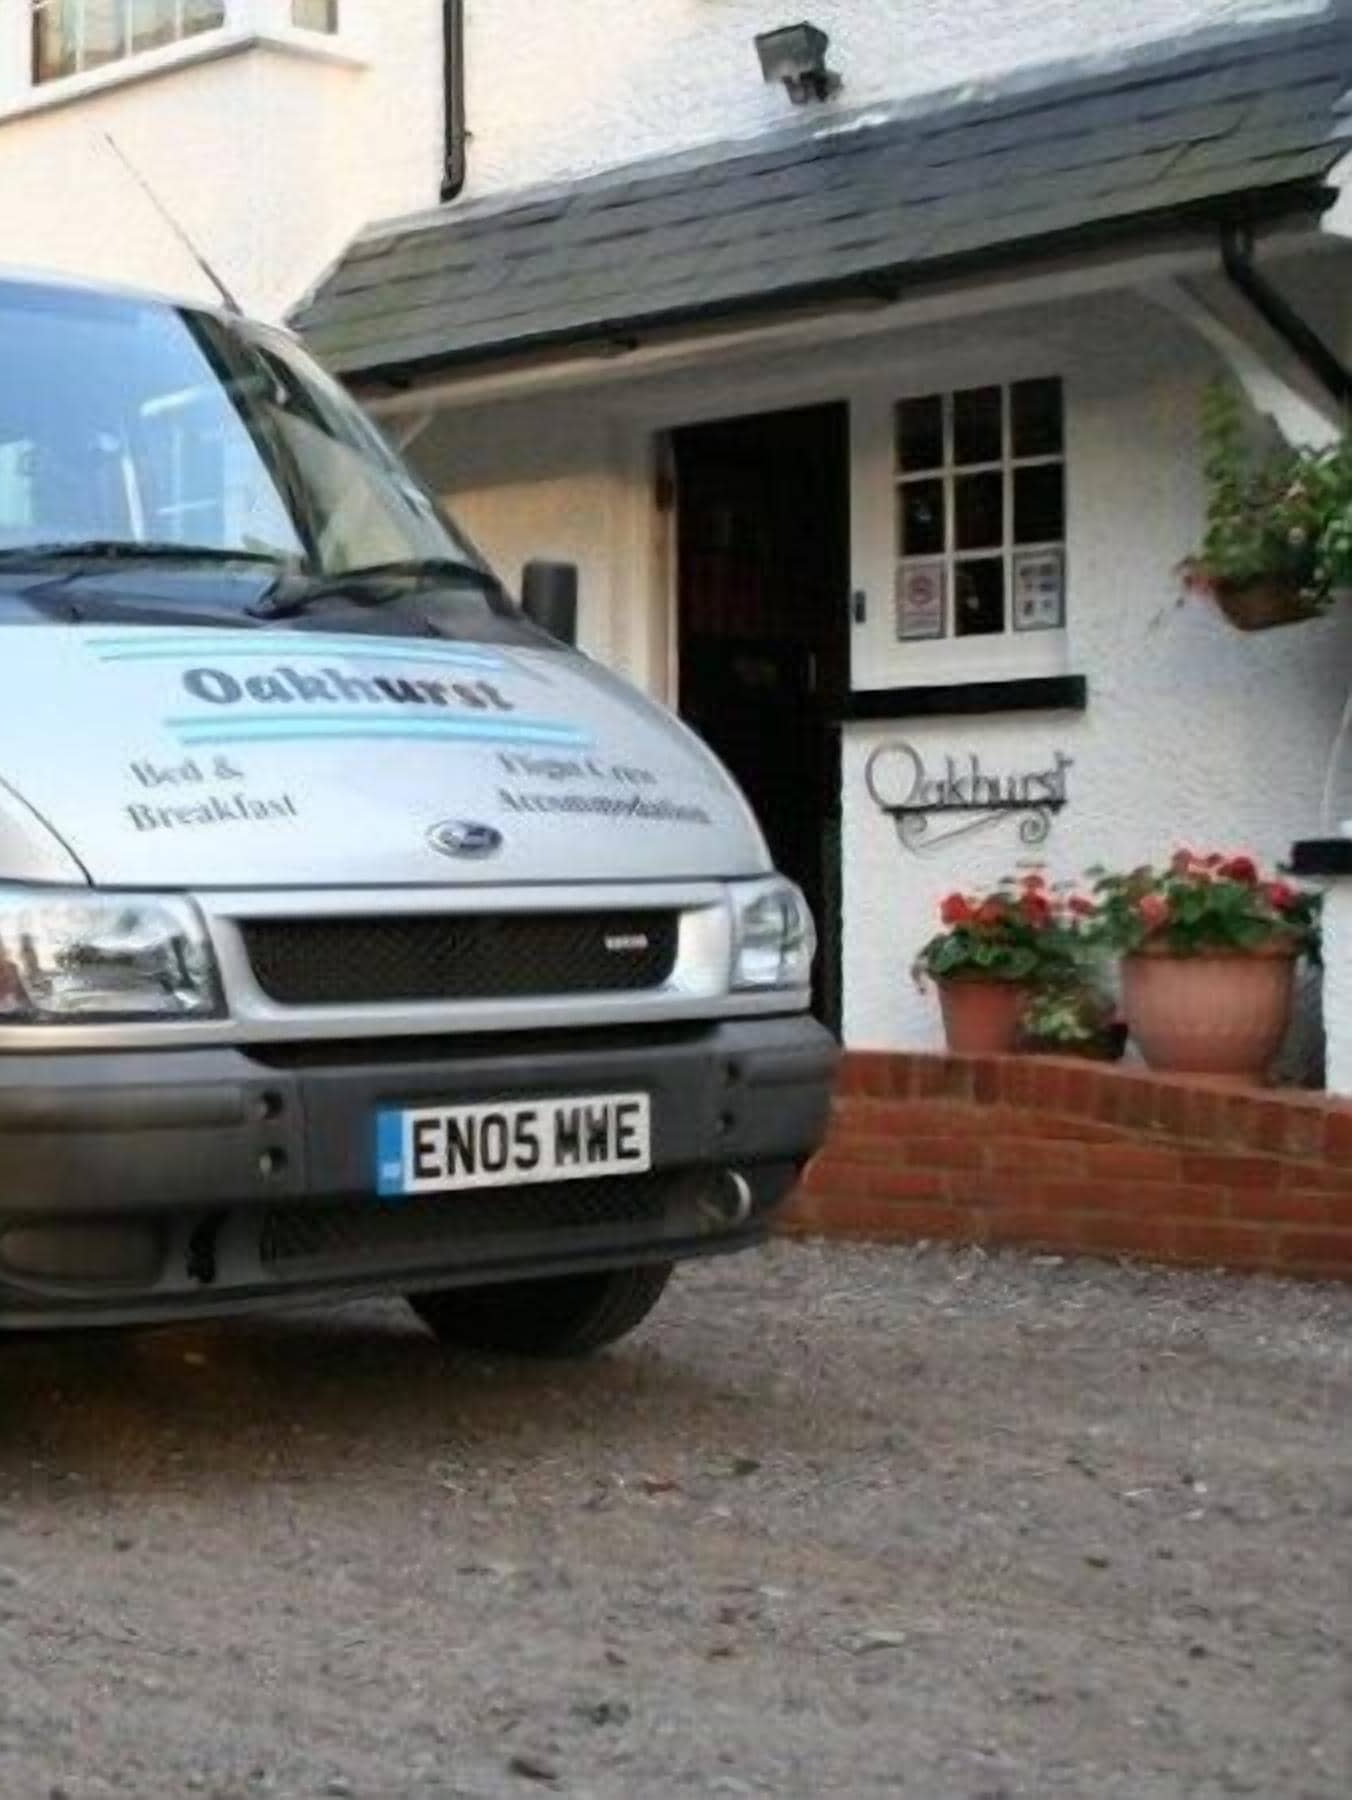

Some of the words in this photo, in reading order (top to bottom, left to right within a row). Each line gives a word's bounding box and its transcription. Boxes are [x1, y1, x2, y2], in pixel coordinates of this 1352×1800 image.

[182, 667, 516, 711] Oakhurst
[130, 759, 204, 788] Bed
[865, 742, 1074, 810] Oakhurst
[127, 792, 299, 833] Breakfast
[412, 1110, 541, 1180] EN05
[554, 1102, 641, 1167] MWE
